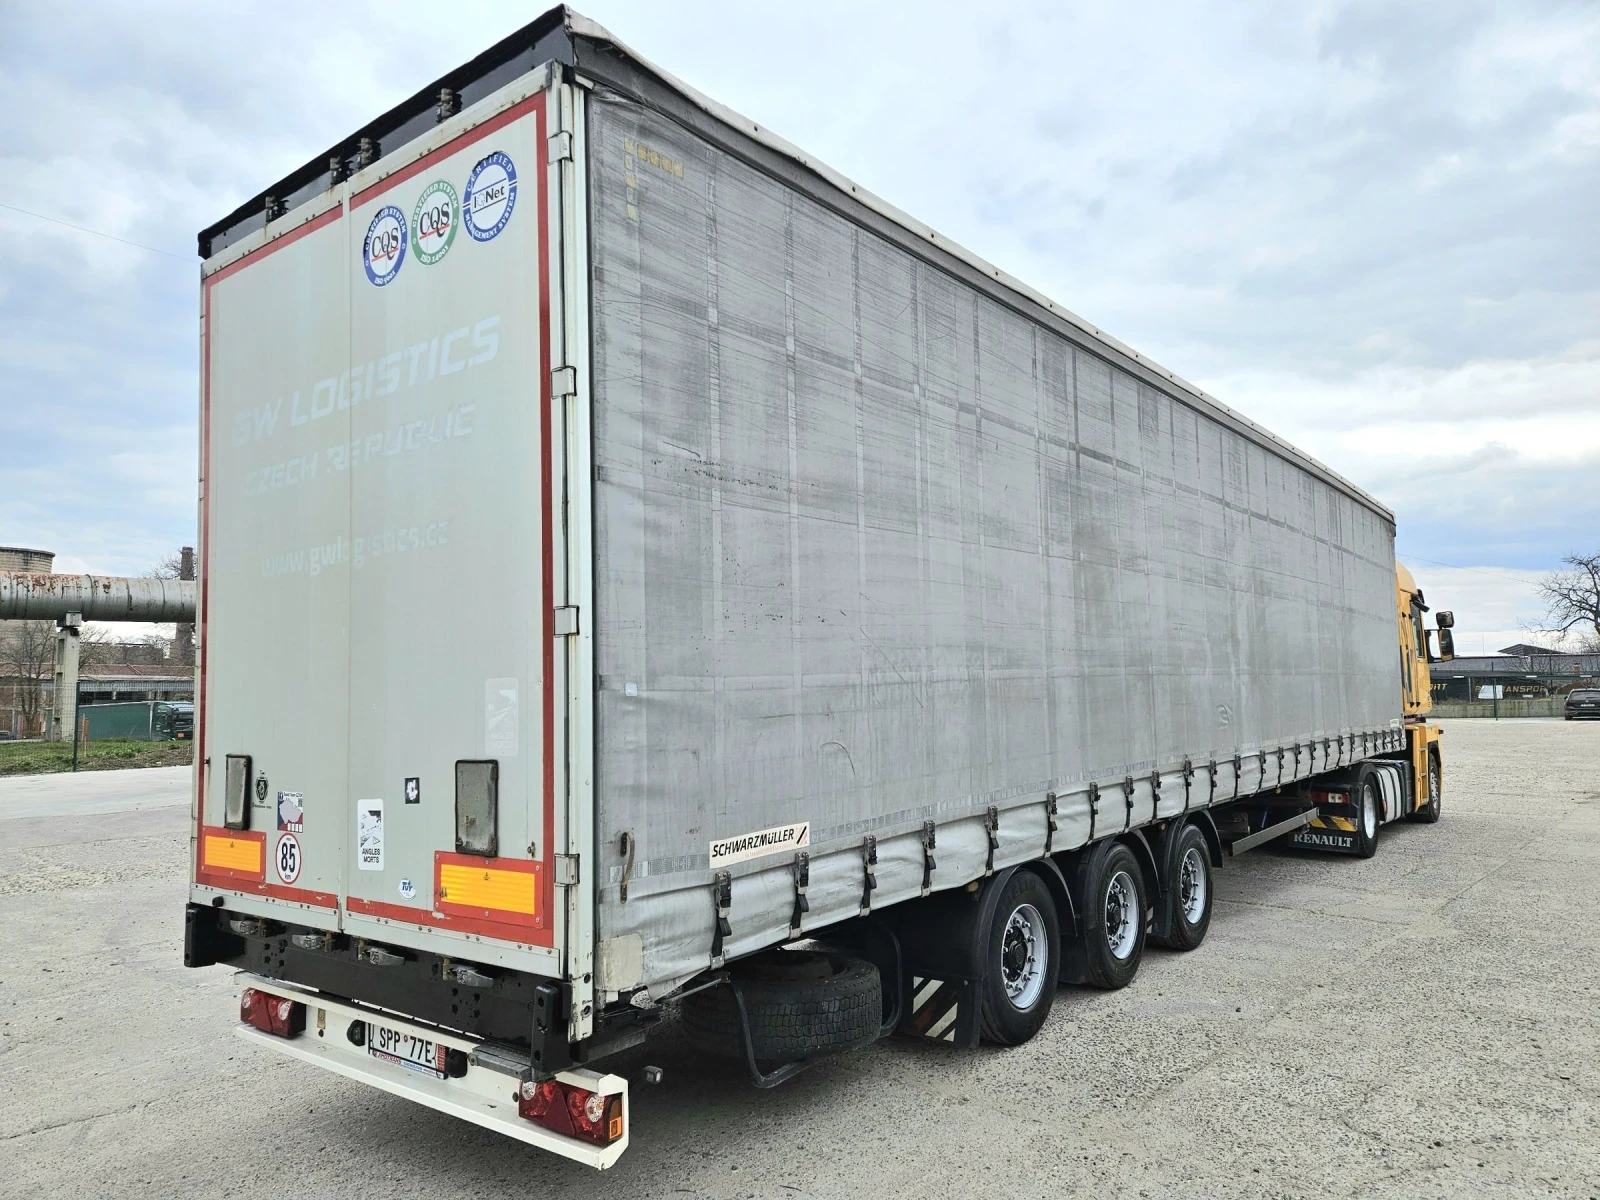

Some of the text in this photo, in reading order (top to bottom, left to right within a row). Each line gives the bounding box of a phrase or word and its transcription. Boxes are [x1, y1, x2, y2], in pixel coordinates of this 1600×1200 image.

[439, 182, 458, 209] SYSTEM
[498, 192, 515, 229] SYSTEM
[420, 201, 450, 238] CQS
[371, 227, 399, 261] CQS
[421, 253, 431, 263] ISO
[291, 314, 501, 428] LOGISTICS
[362, 848, 381, 856] ANGLES
[712, 828, 794, 858] SCHWARZMÜLLER
[1293, 833, 1353, 848] RENAULT
[281, 842, 296, 873] 85
[363, 856, 380, 864] MORTS
[380, 1027, 401, 1052] SPP
[410, 1036, 433, 1064] 77E
